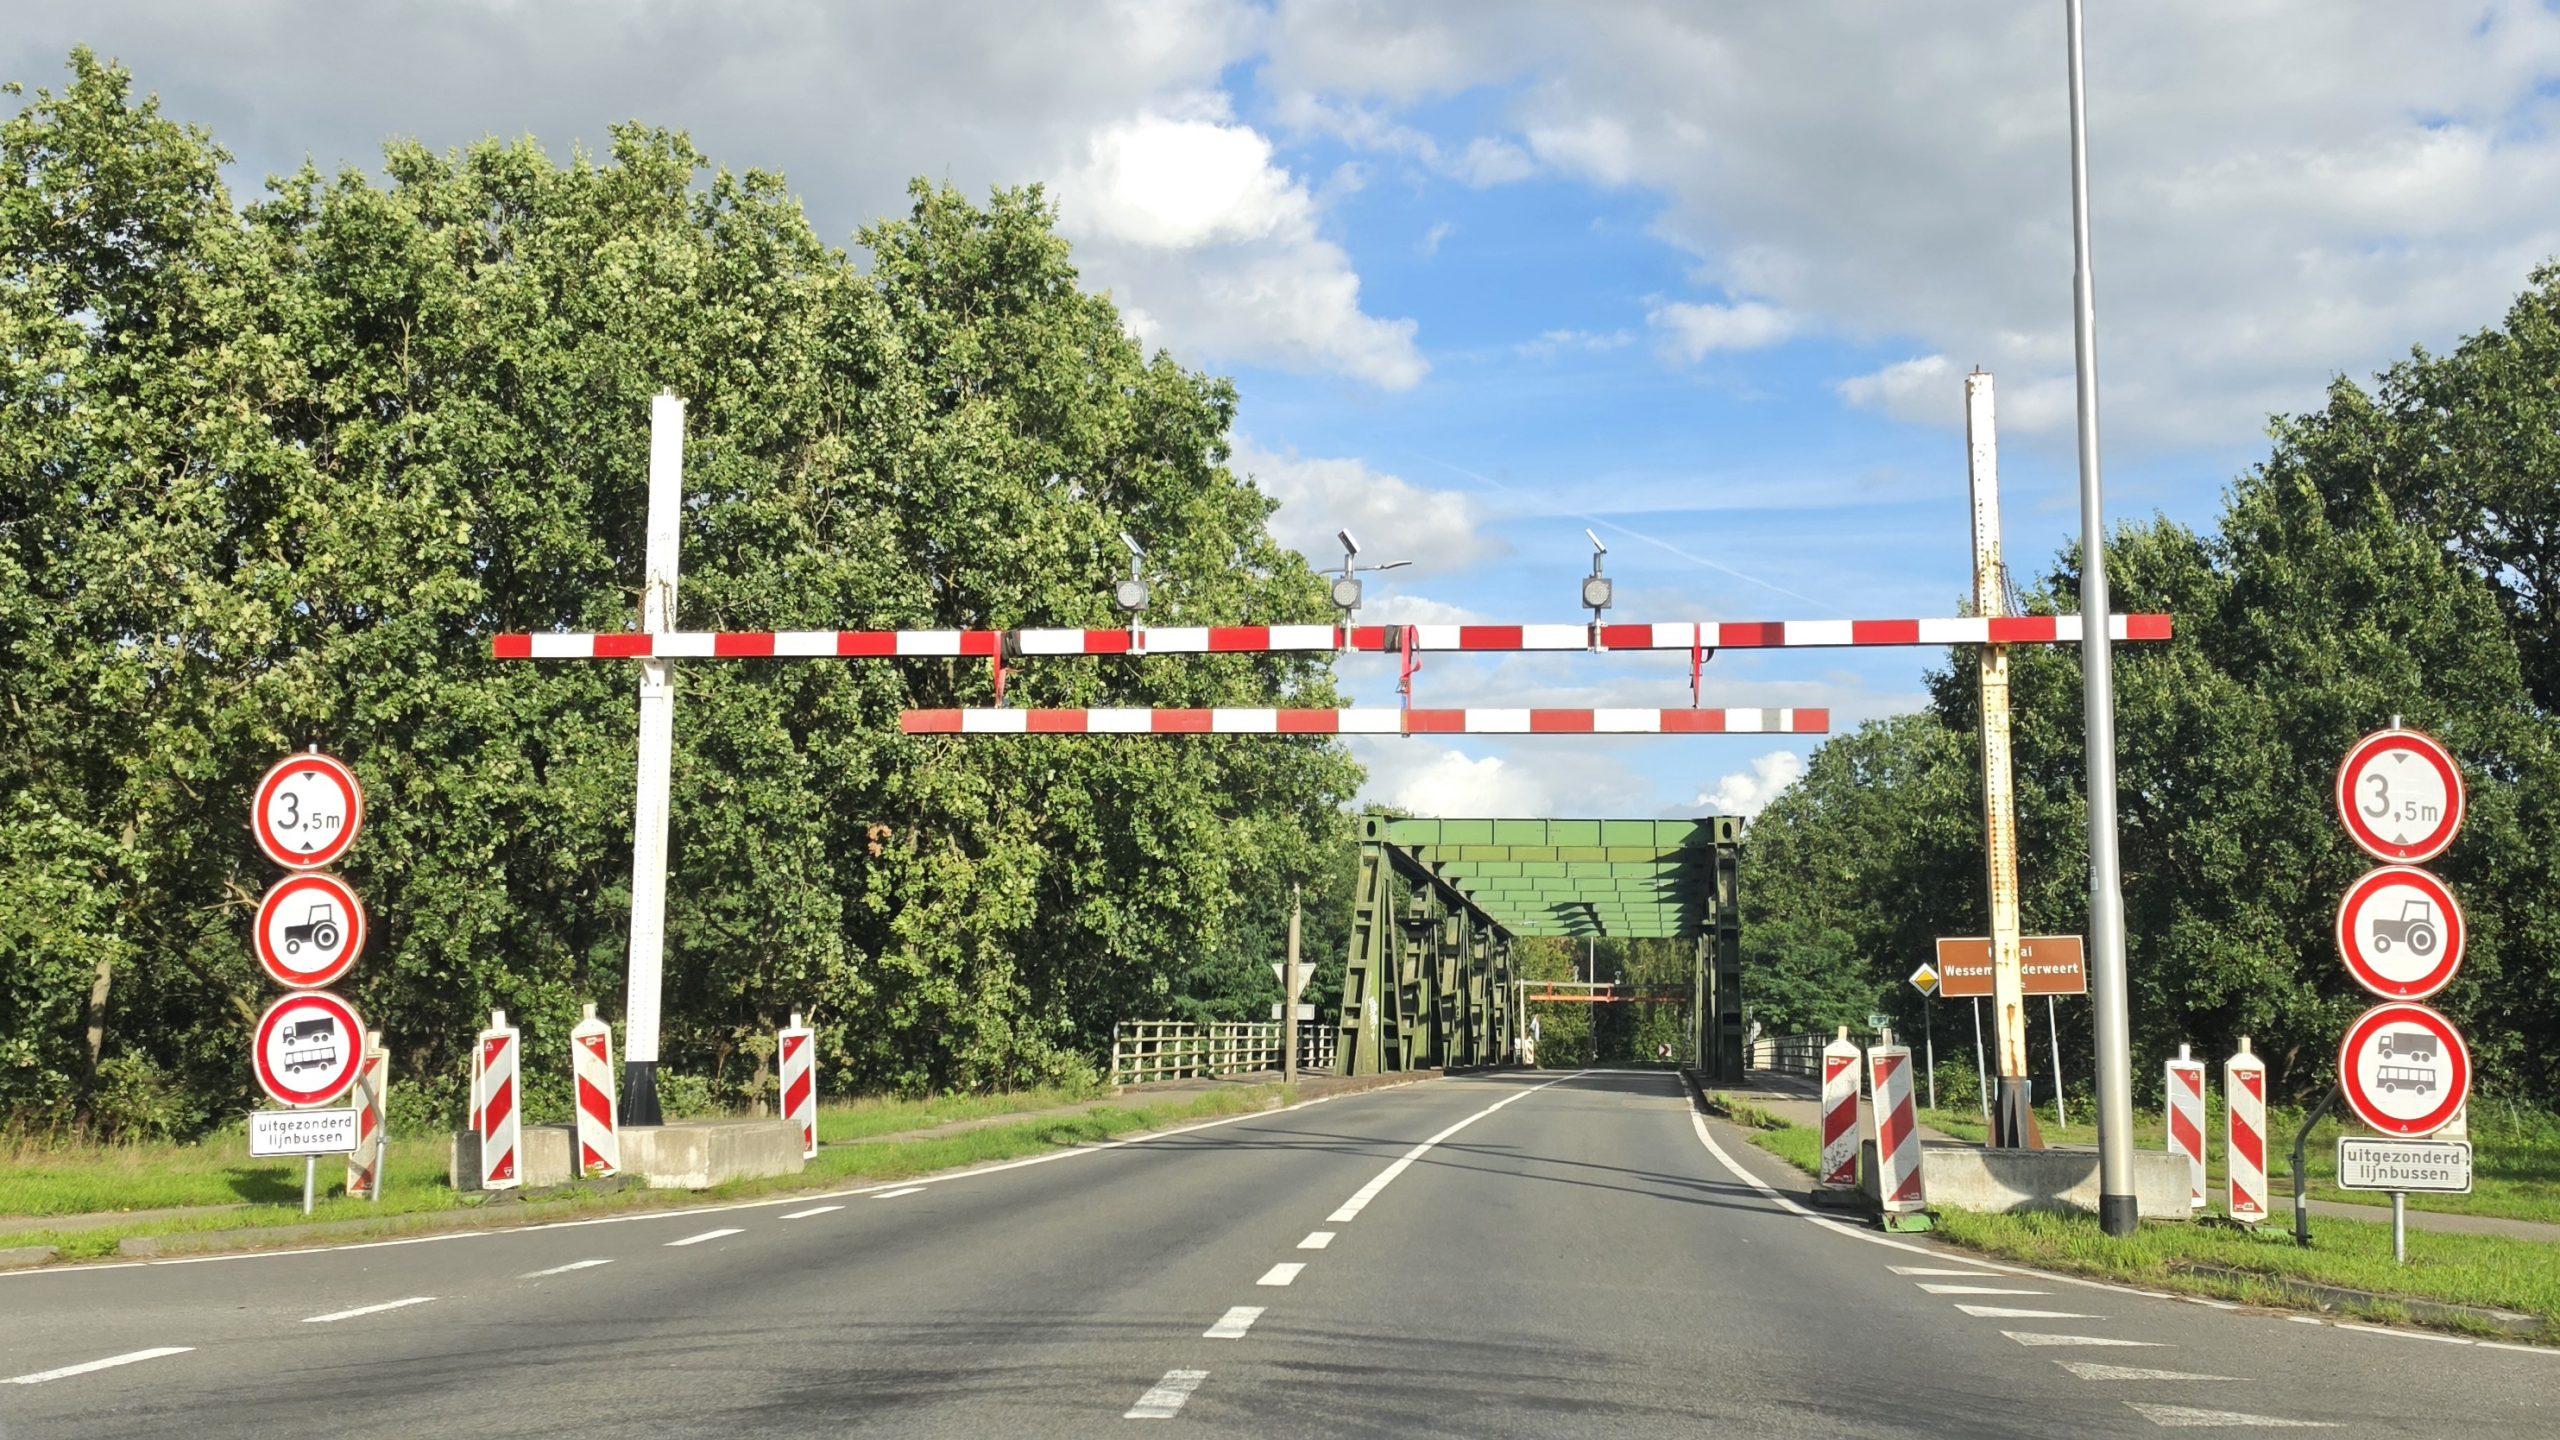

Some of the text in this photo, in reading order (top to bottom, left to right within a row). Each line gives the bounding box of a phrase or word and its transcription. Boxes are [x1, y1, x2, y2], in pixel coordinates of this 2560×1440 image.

[259, 1116, 352, 1134] uitgezonderd
[269, 1133, 342, 1149] lijnbussen
[2347, 1149, 2460, 1166] uitgezonderd
[2361, 1165, 2449, 1182] lijnbussen
